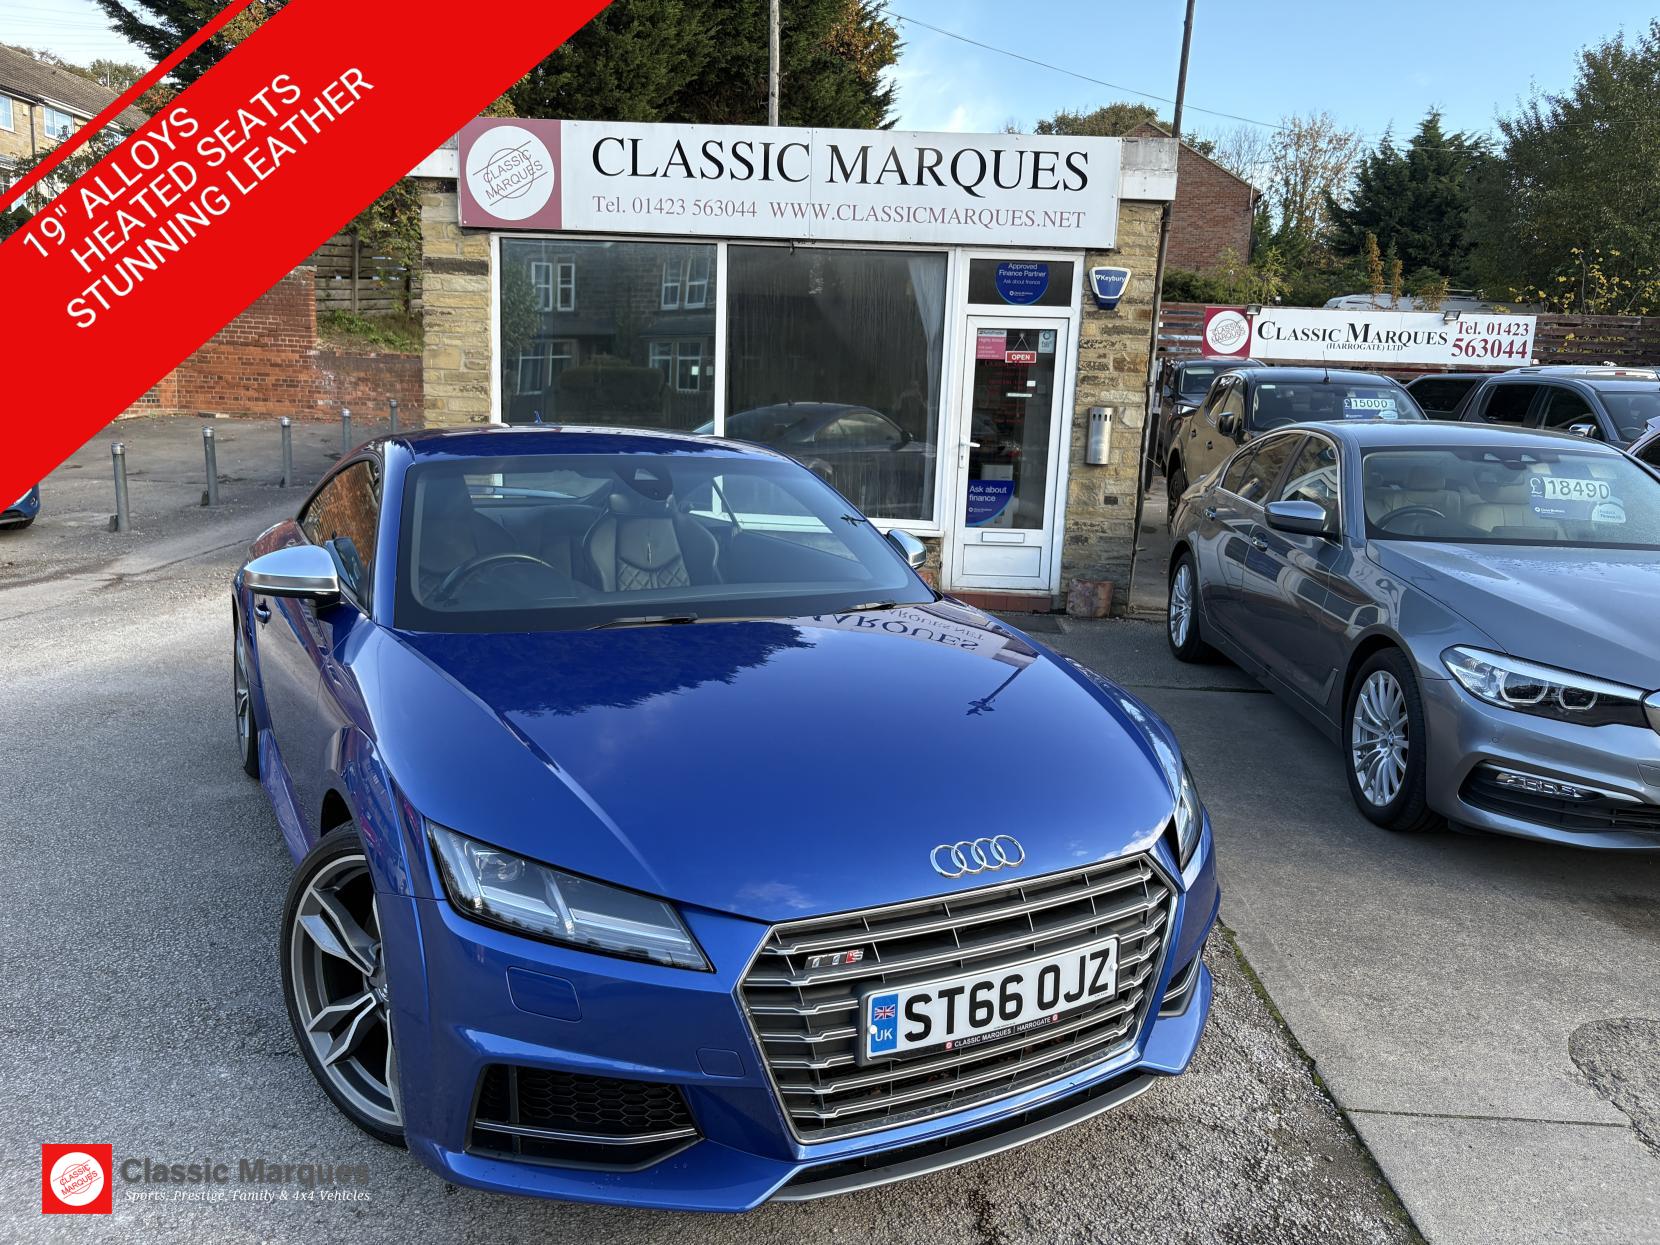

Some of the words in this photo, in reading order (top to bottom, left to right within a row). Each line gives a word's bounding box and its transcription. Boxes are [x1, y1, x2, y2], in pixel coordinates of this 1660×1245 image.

[482, 149, 533, 183] CLASSIC
[592, 136, 810, 183] CLASSIC
[825, 144, 1089, 199] MARQUES
[485, 160, 544, 200] MARQUES
[592, 195, 626, 214] Tel.
[632, 197, 686, 215] 01423
[692, 199, 757, 218] 563044
[769, 201, 1086, 230] WWW.CLASSICMARQUES.NET
[999, 269, 1023, 277] Finance
[1456, 320, 1481, 335] Tel.
[1486, 321, 1529, 336] 01423
[1326, 342, 1385, 352] (HARROGATE)
[1450, 337, 1528, 359] 563044
[1011, 353, 1031, 361] OPEN
[969, 485, 984, 493] Ask
[985, 486, 1007, 494] about
[969, 494, 996, 502] finance
[903, 973, 1024, 1043] ST66
[874, 1027, 893, 1042] UK
[954, 1035, 980, 1048] CLASSIC
[982, 1028, 1012, 1042] MARQUES
[1016, 1017, 1051, 1032] HARROGATE
